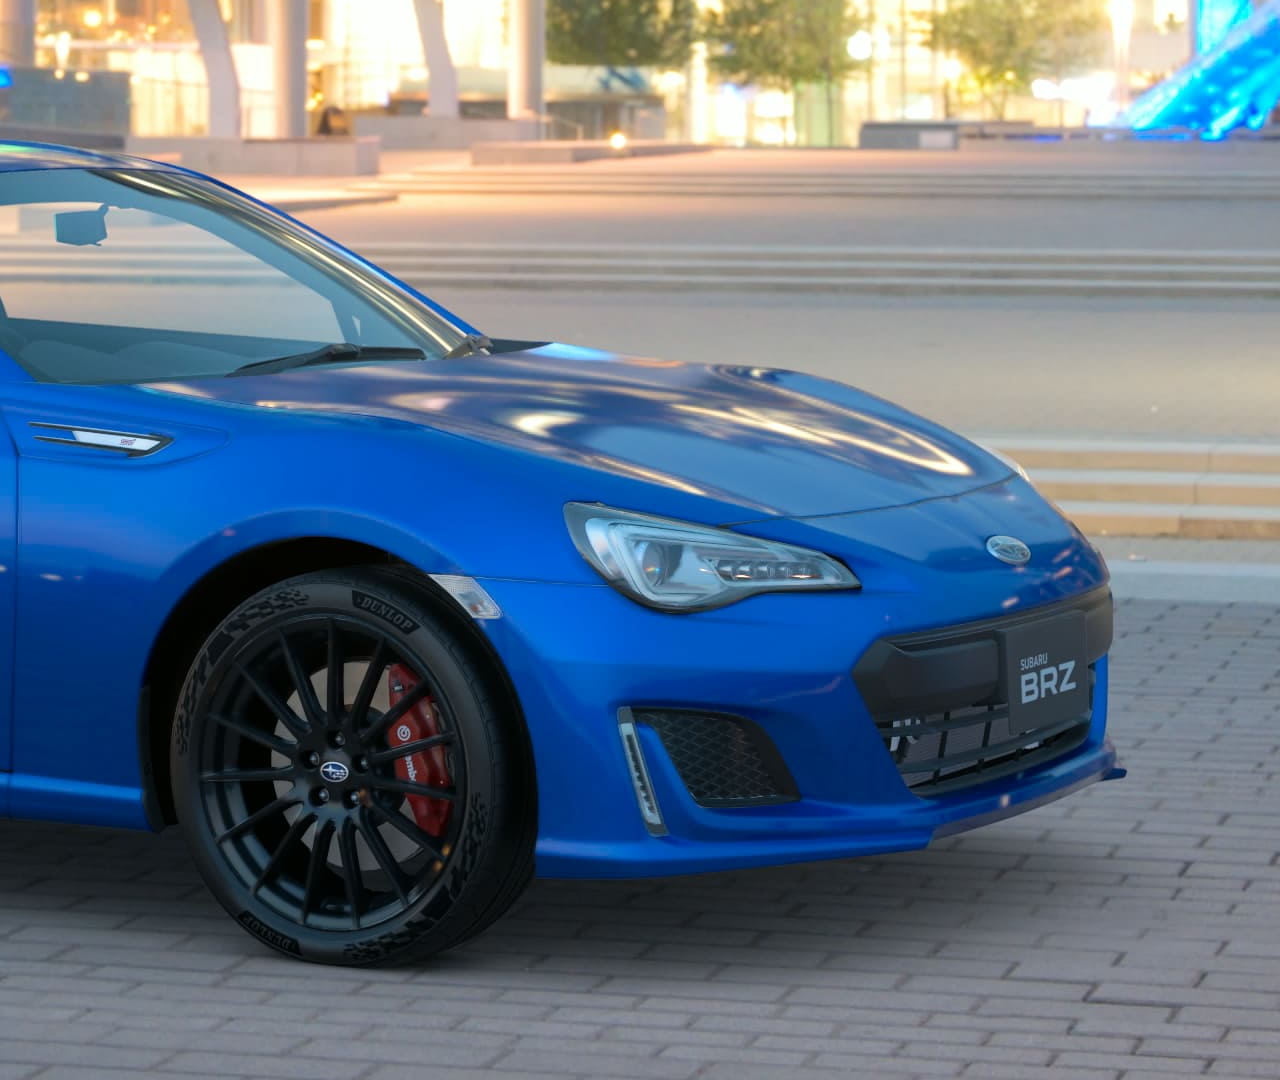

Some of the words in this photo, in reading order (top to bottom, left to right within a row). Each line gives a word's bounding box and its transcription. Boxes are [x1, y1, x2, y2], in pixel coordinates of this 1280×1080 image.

[361, 597, 414, 629] DUNLOP
[1020, 652, 1048, 671] SUBARU
[1021, 660, 1077, 705] BRZ
